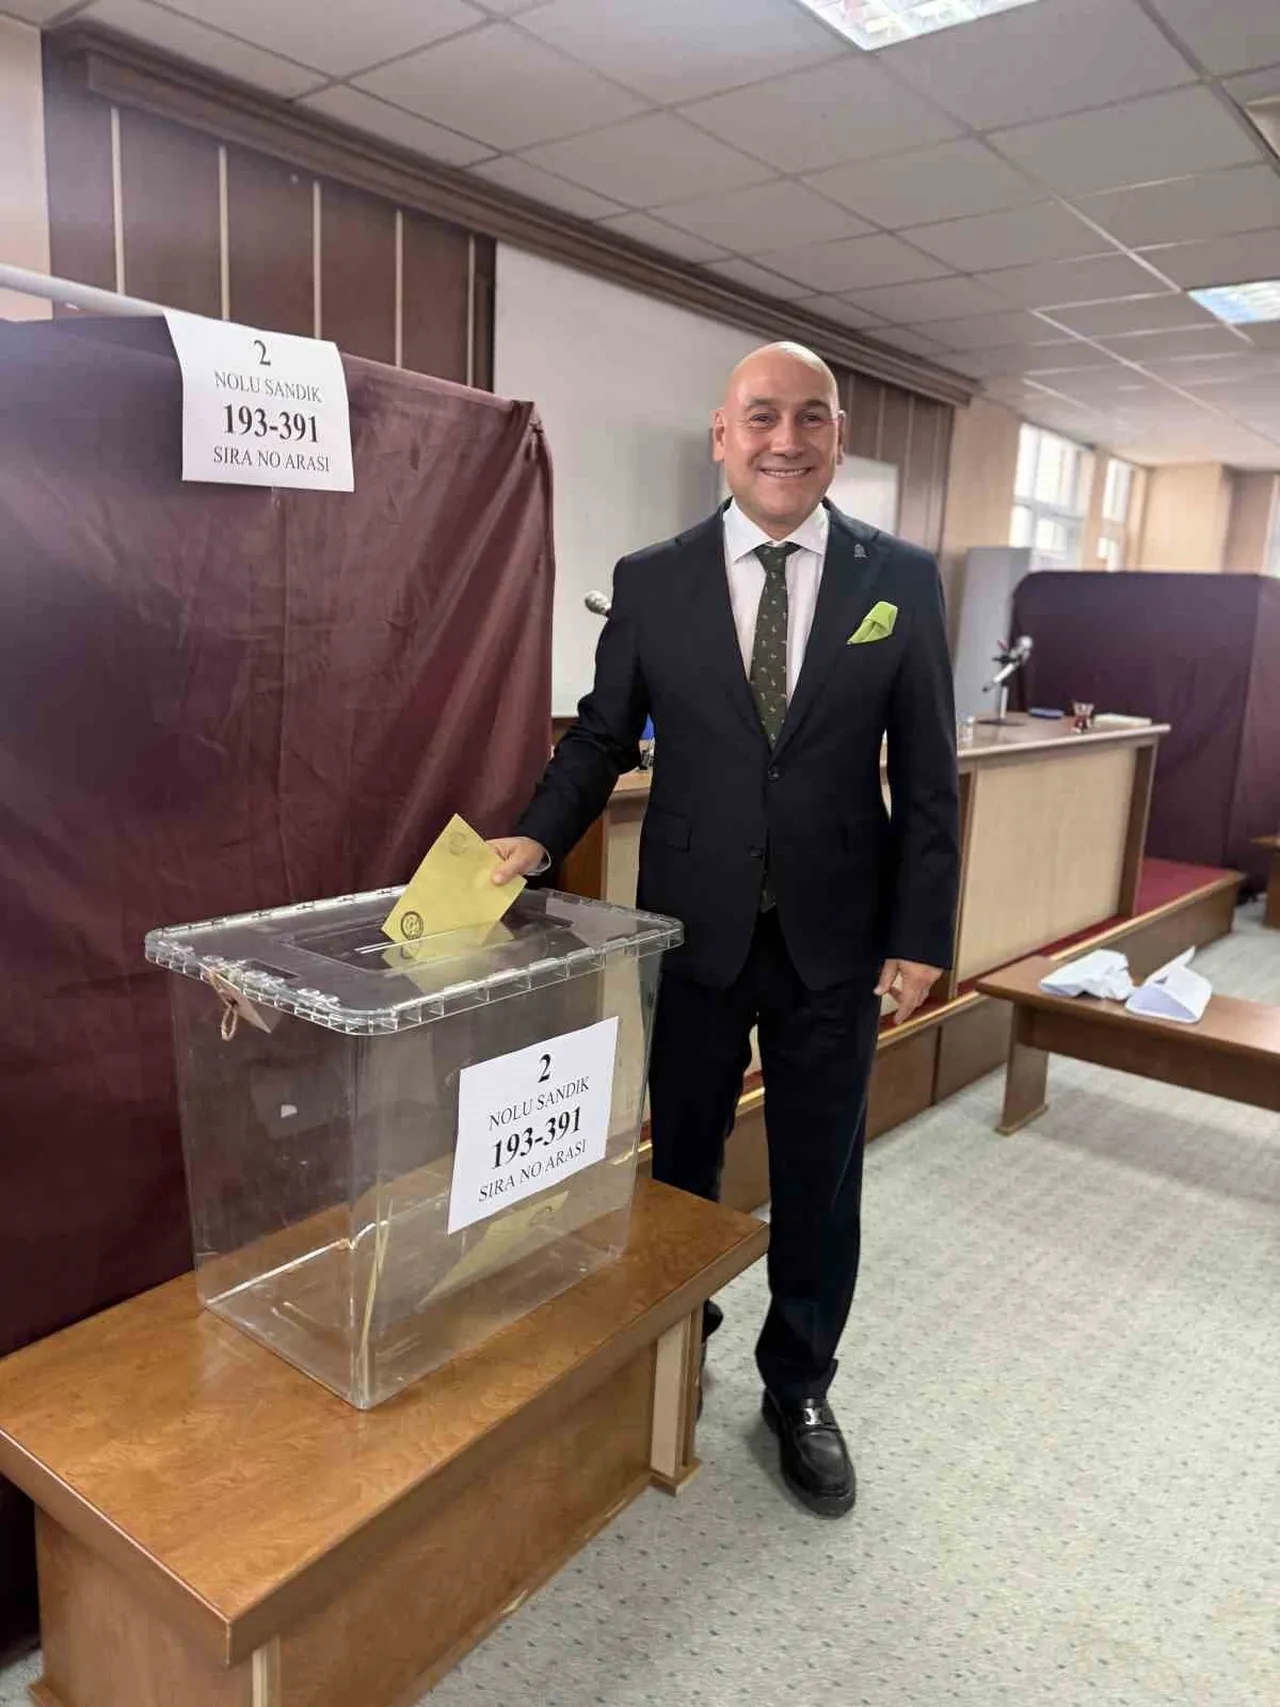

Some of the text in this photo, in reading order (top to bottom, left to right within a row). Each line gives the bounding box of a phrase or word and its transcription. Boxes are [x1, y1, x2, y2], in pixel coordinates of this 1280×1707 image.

[254, 339, 271, 366] 2
[214, 371, 323, 403] NOLU SANDIK
[223, 404, 318, 443] 193-391
[213, 446, 330, 472] SIRA NO ARASI
[537, 1053, 551, 1083] 2
[488, 1076, 590, 1130] NOLU SANDIK
[491, 1106, 581, 1169] 193-391
[478, 1138, 587, 1202] SIRA NO ARASI
